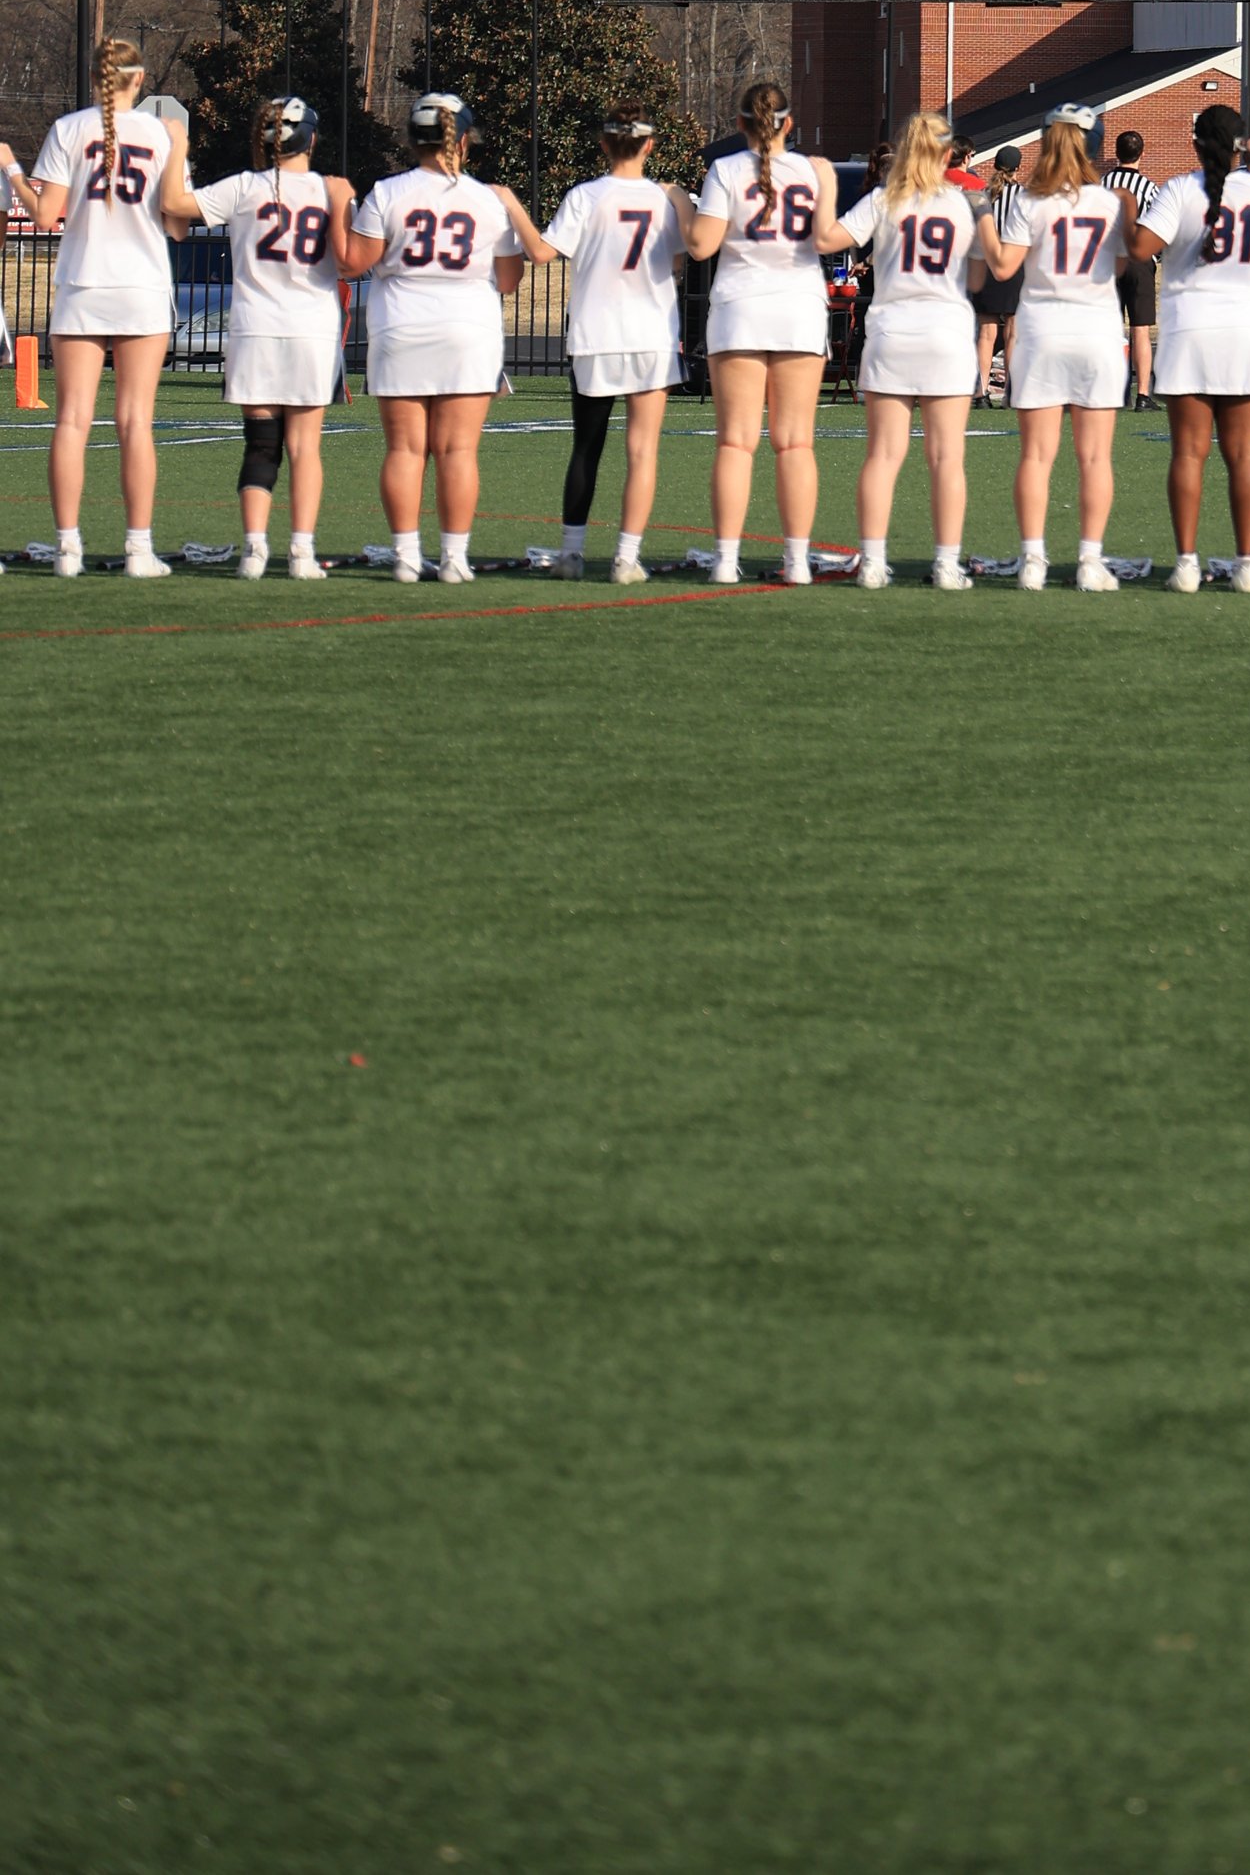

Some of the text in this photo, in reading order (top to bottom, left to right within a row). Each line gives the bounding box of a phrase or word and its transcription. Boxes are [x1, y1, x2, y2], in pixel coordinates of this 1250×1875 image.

[85, 140, 154, 204] 25
[256, 202, 331, 265] 28
[401, 208, 476, 272] 33
[619, 210, 652, 270] 7
[745, 181, 814, 241] 26
[900, 214, 956, 275] 19
[1052, 216, 1106, 275] 17
